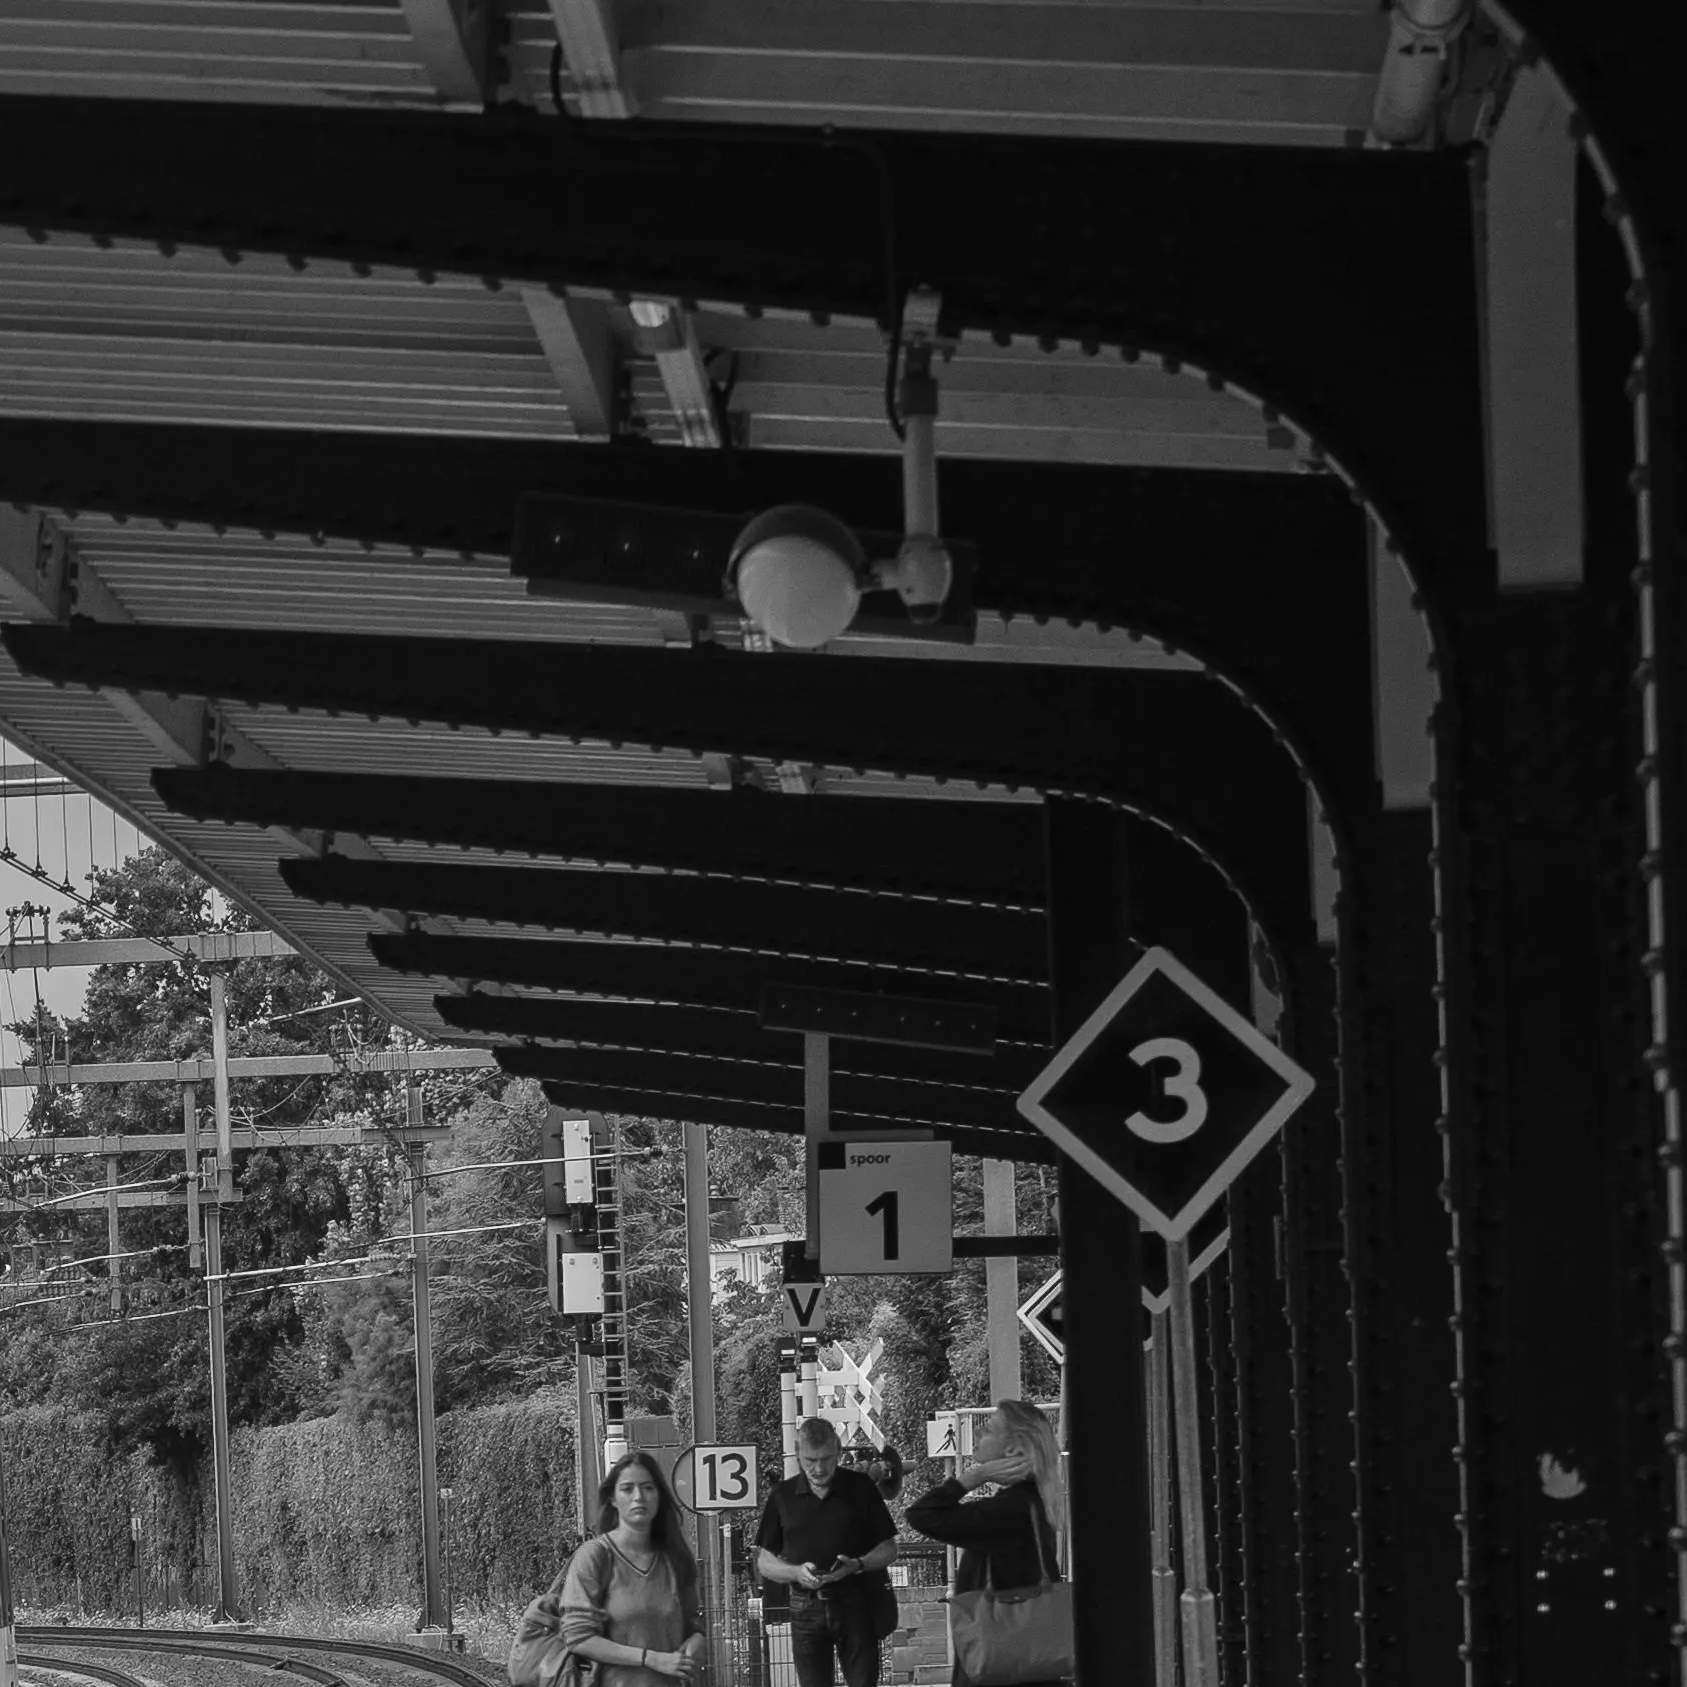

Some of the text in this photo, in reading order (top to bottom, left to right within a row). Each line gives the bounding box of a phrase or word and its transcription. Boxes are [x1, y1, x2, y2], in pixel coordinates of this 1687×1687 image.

[1125, 1037, 1208, 1144] 3
[849, 1154, 891, 1167] spoor
[865, 1190, 899, 1260] 1
[786, 1288, 821, 1327] V
[702, 1453, 749, 1501] 13
